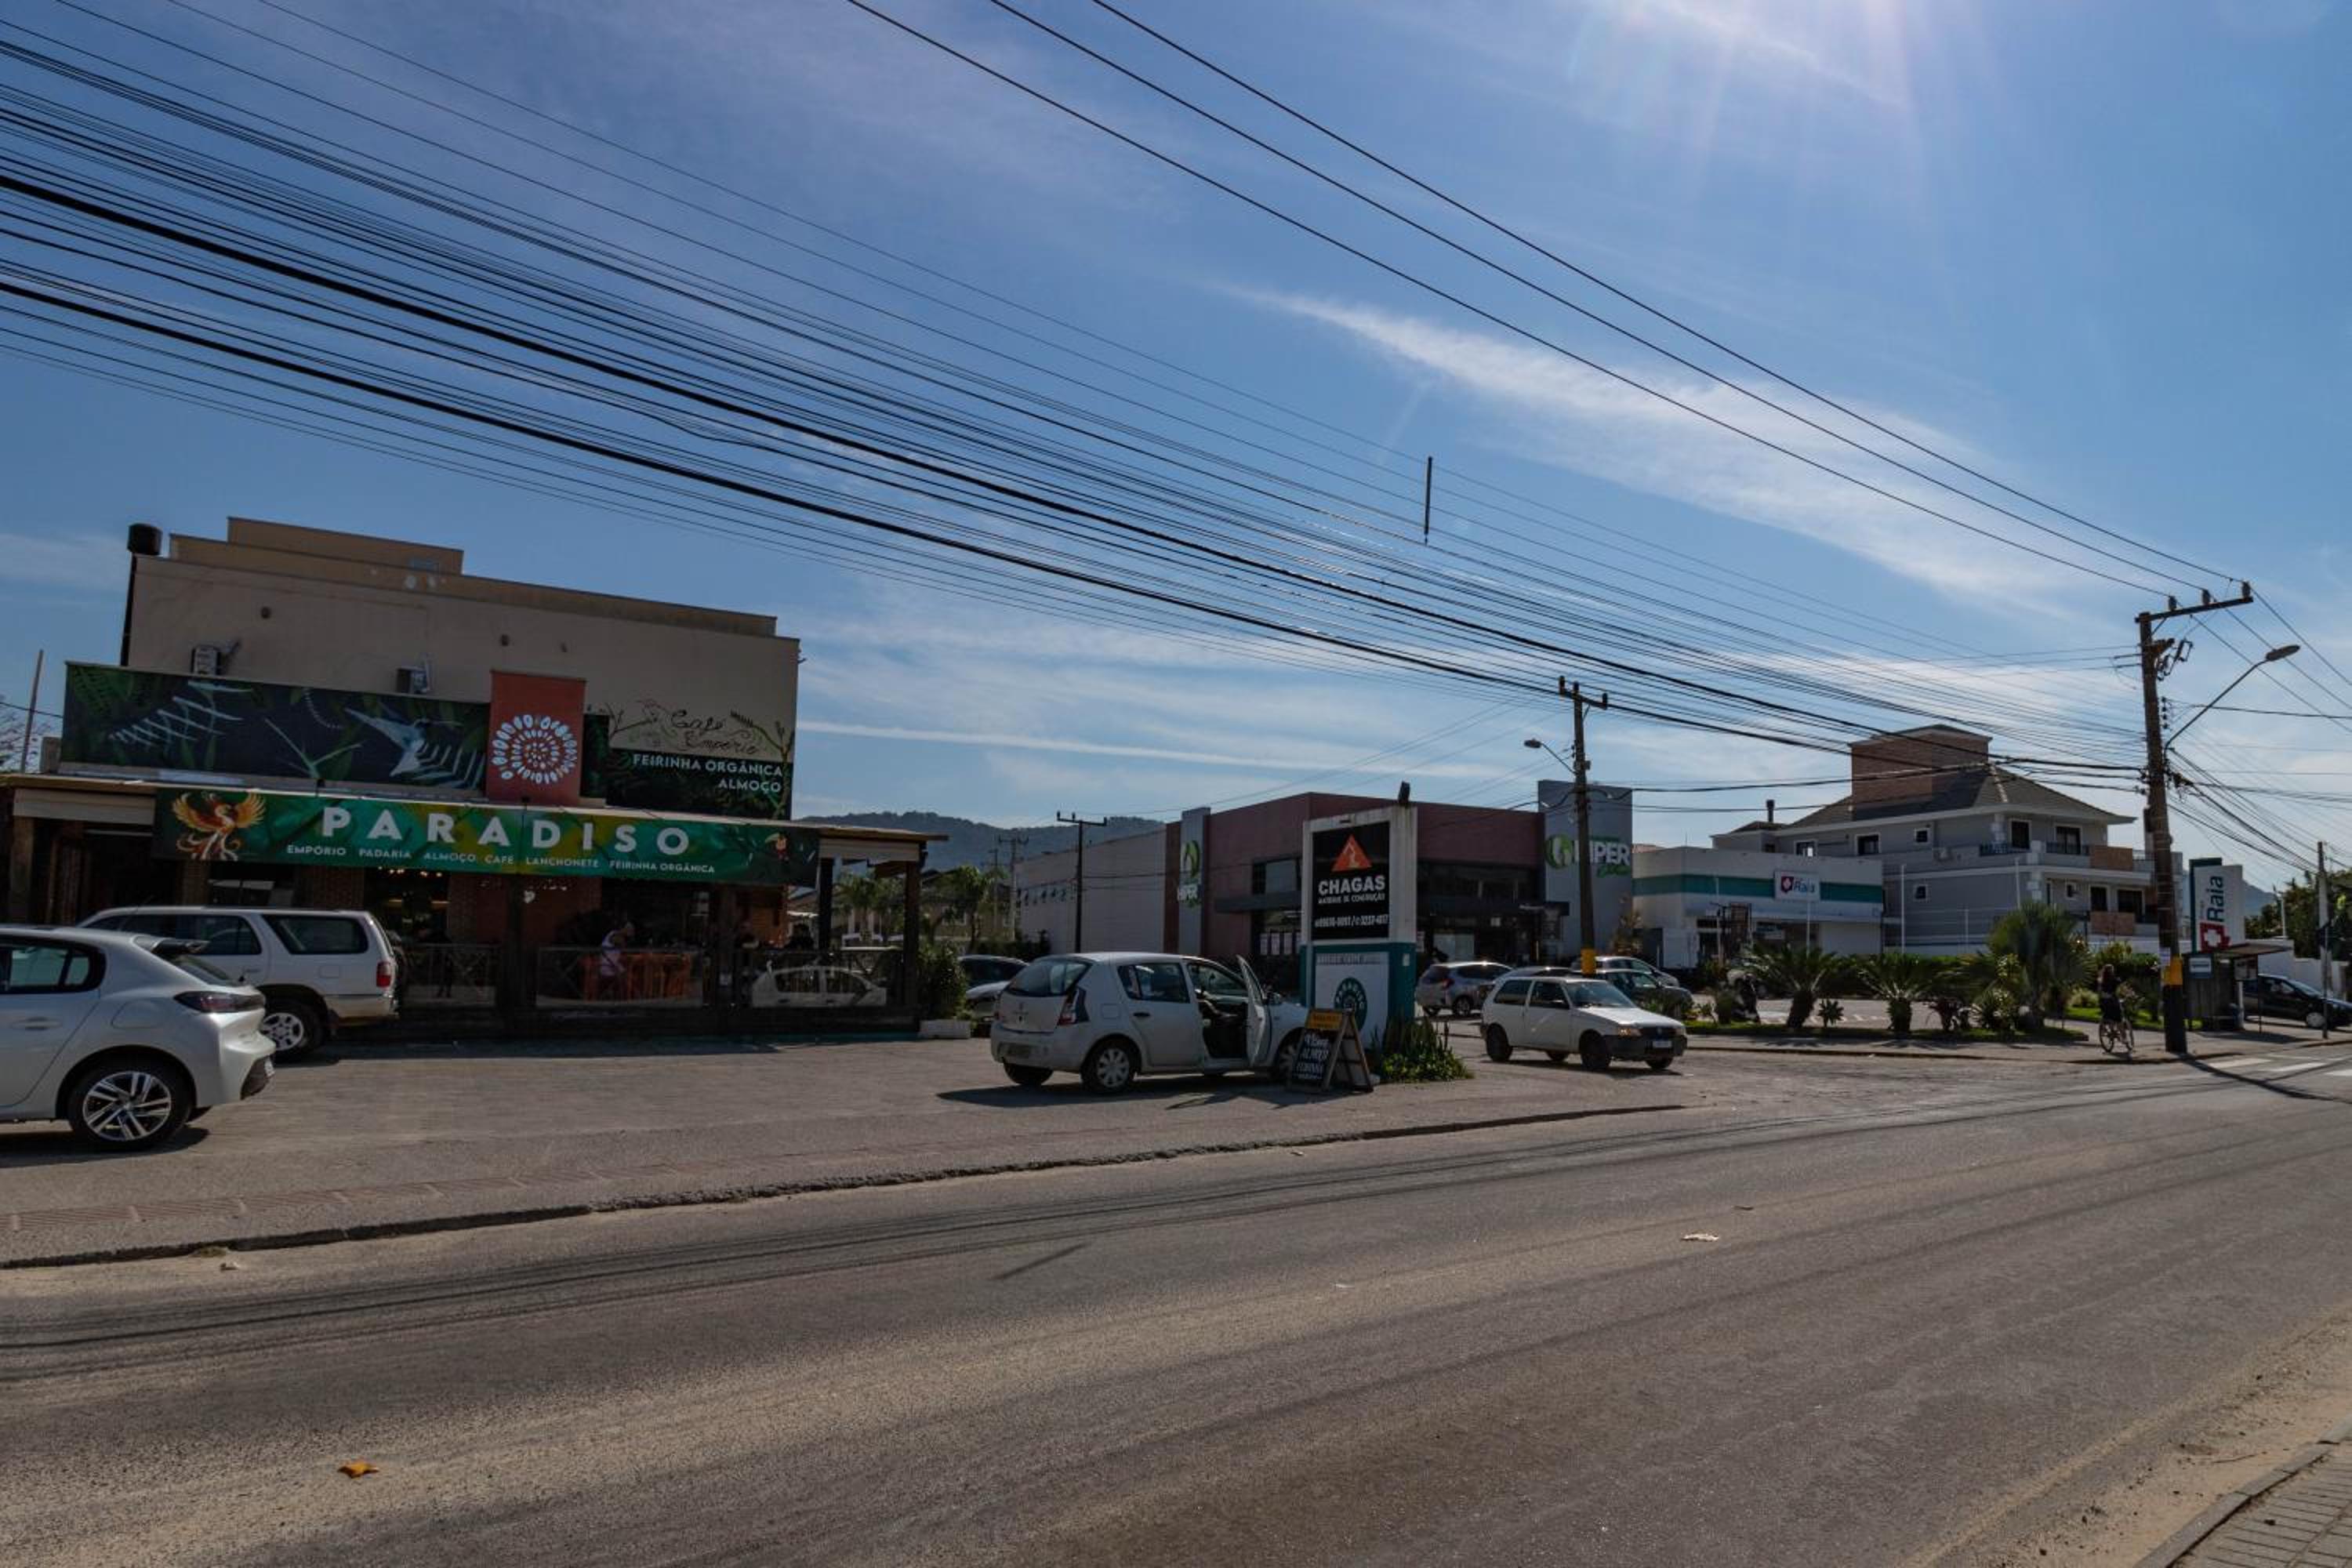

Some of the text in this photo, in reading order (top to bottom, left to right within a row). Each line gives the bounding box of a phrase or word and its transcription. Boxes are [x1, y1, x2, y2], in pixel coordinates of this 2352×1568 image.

[633, 753, 782, 776] FEIRINHA ORGÂNICA
[718, 778, 782, 794] ALMOÇO
[322, 807, 689, 855] PARADISO
[287, 844, 347, 856] EMPÓRIO
[359, 848, 412, 859] PADARIA
[423, 851, 477, 863] ALMOÇO
[526, 857, 599, 868] LANCHONETE
[609, 859, 657, 871] FEIRINHA
[660, 862, 715, 873] ORGÂNICA
[1318, 874, 1385, 895] CHAGAS
[2206, 876, 2225, 922] Raia
